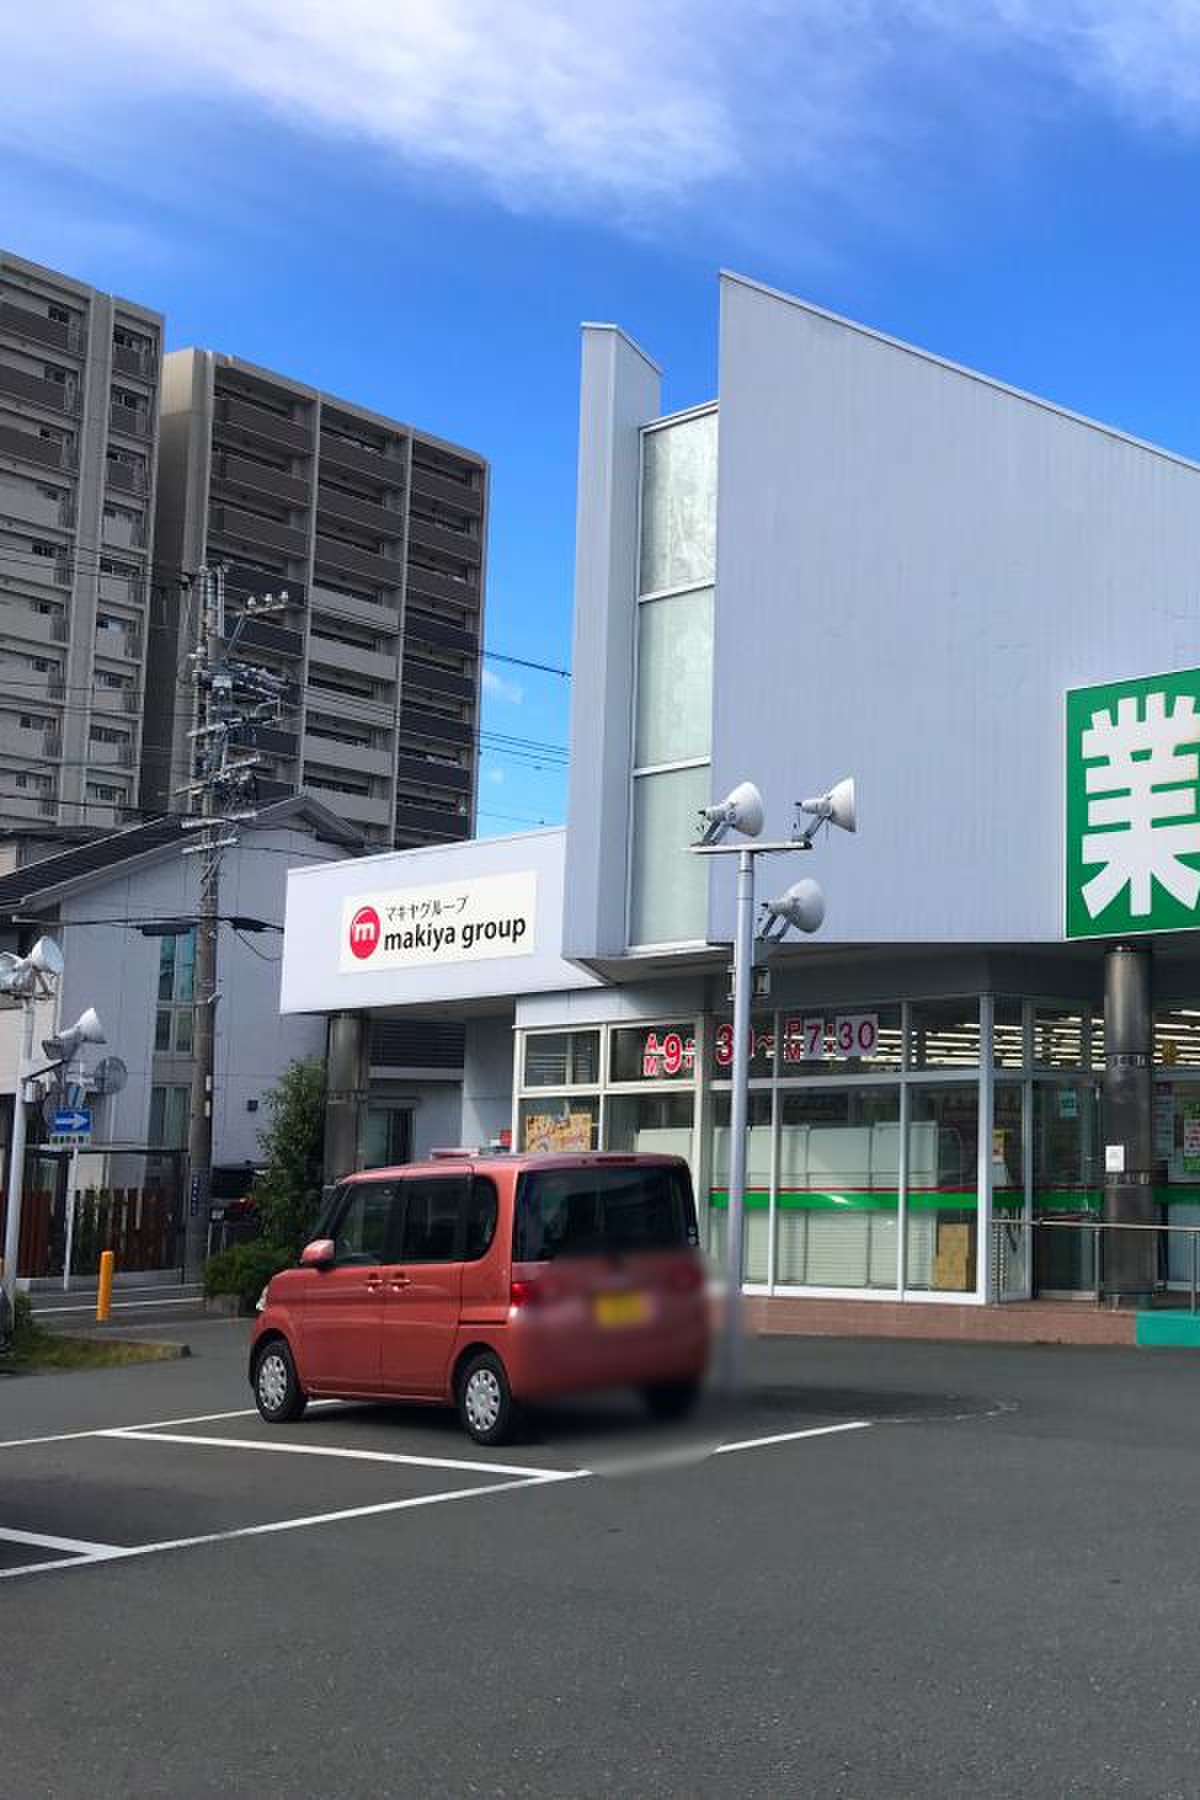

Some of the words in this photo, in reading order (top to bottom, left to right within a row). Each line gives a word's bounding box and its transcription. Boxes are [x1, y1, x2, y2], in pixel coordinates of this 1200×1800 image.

[385, 895, 469, 923] マキヤグループ
[384, 923, 455, 952] makiya
[462, 917, 526, 949] group
